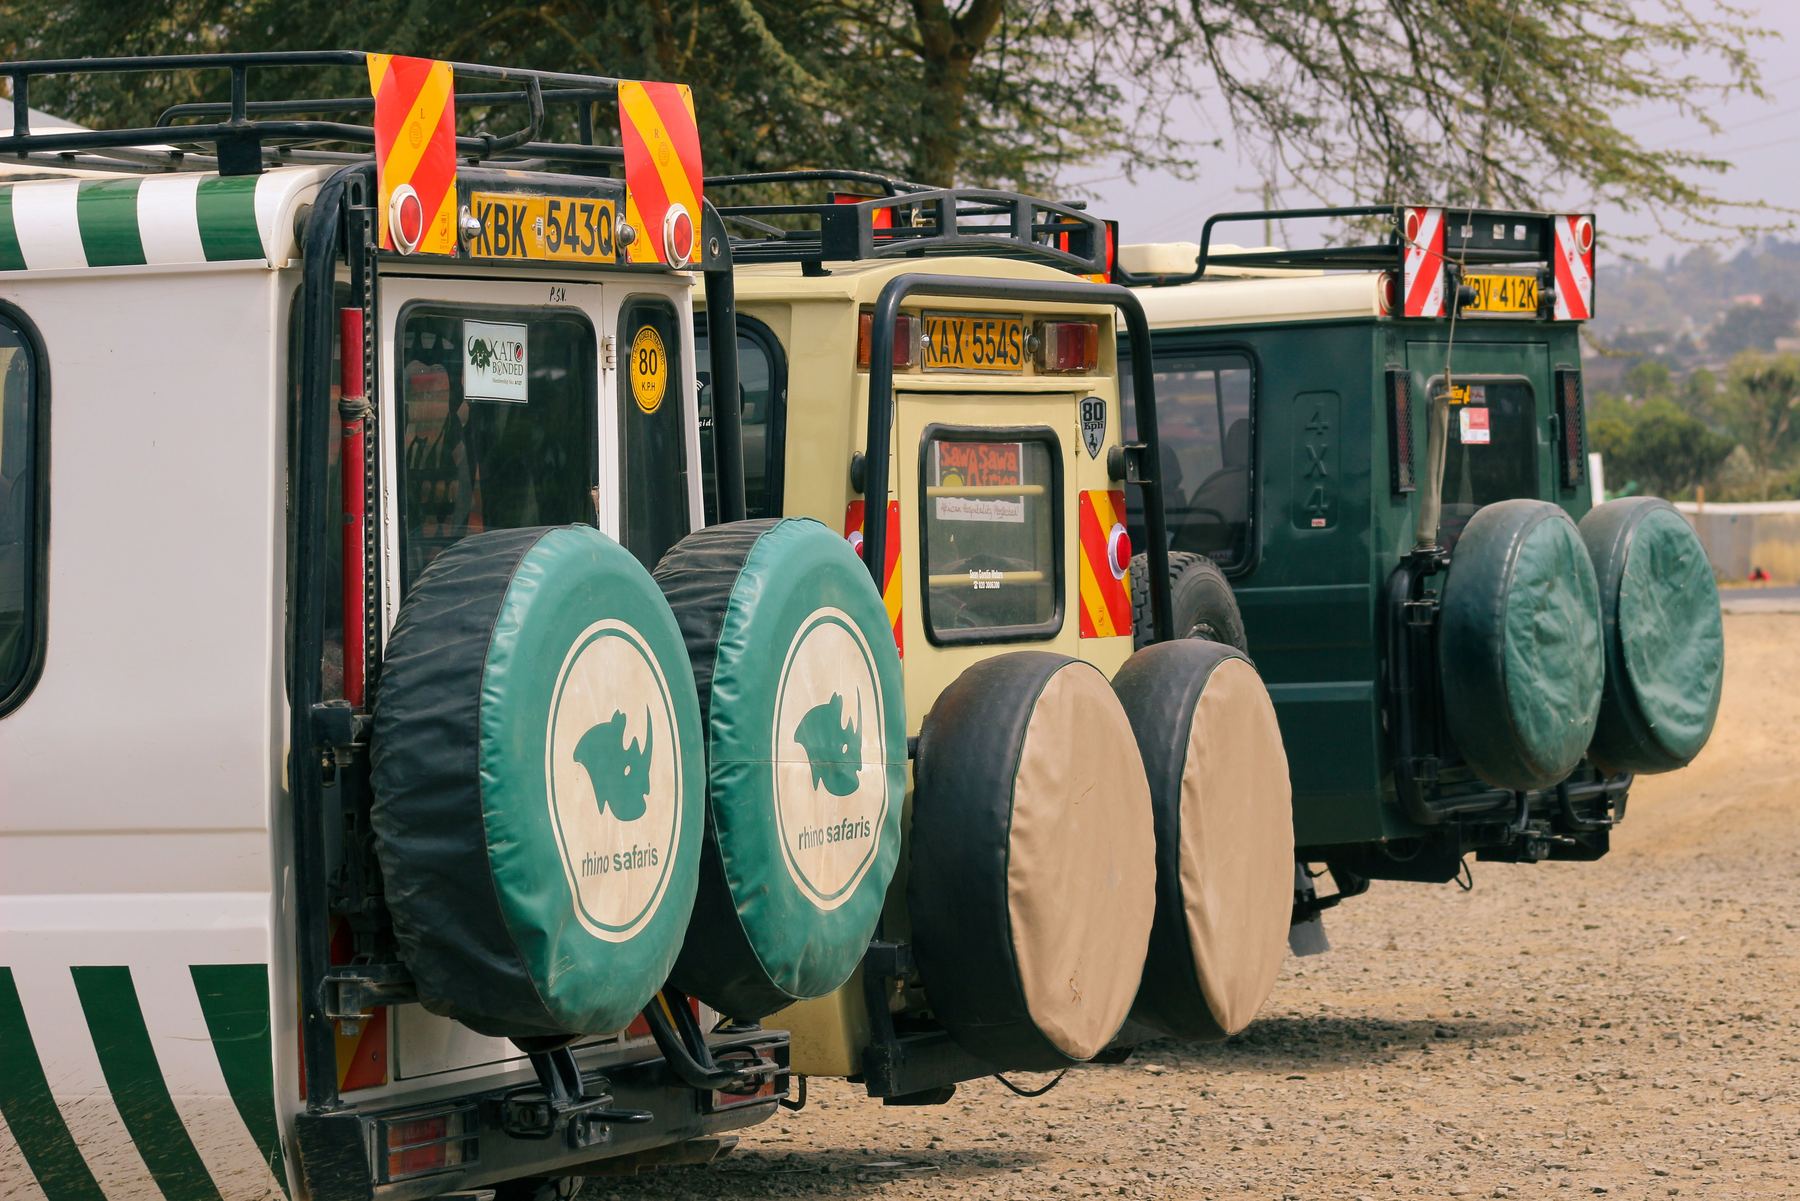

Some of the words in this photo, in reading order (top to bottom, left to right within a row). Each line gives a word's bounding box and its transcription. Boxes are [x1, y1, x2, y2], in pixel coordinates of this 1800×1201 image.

[476, 200, 527, 257] KBK
[546, 200, 613, 256] 543Q
[1500, 277, 1537, 309] 412K
[489, 339, 523, 362] KATO
[926, 319, 964, 364] KAX
[973, 320, 1020, 365] 554S
[492, 361, 524, 376] BONDED
[639, 348, 658, 375] 80
[1083, 402, 1104, 421] 80
[798, 824, 824, 850] rhino
[826, 815, 871, 843] safaris
[581, 852, 609, 877] rhino
[613, 843, 659, 872] safaris
